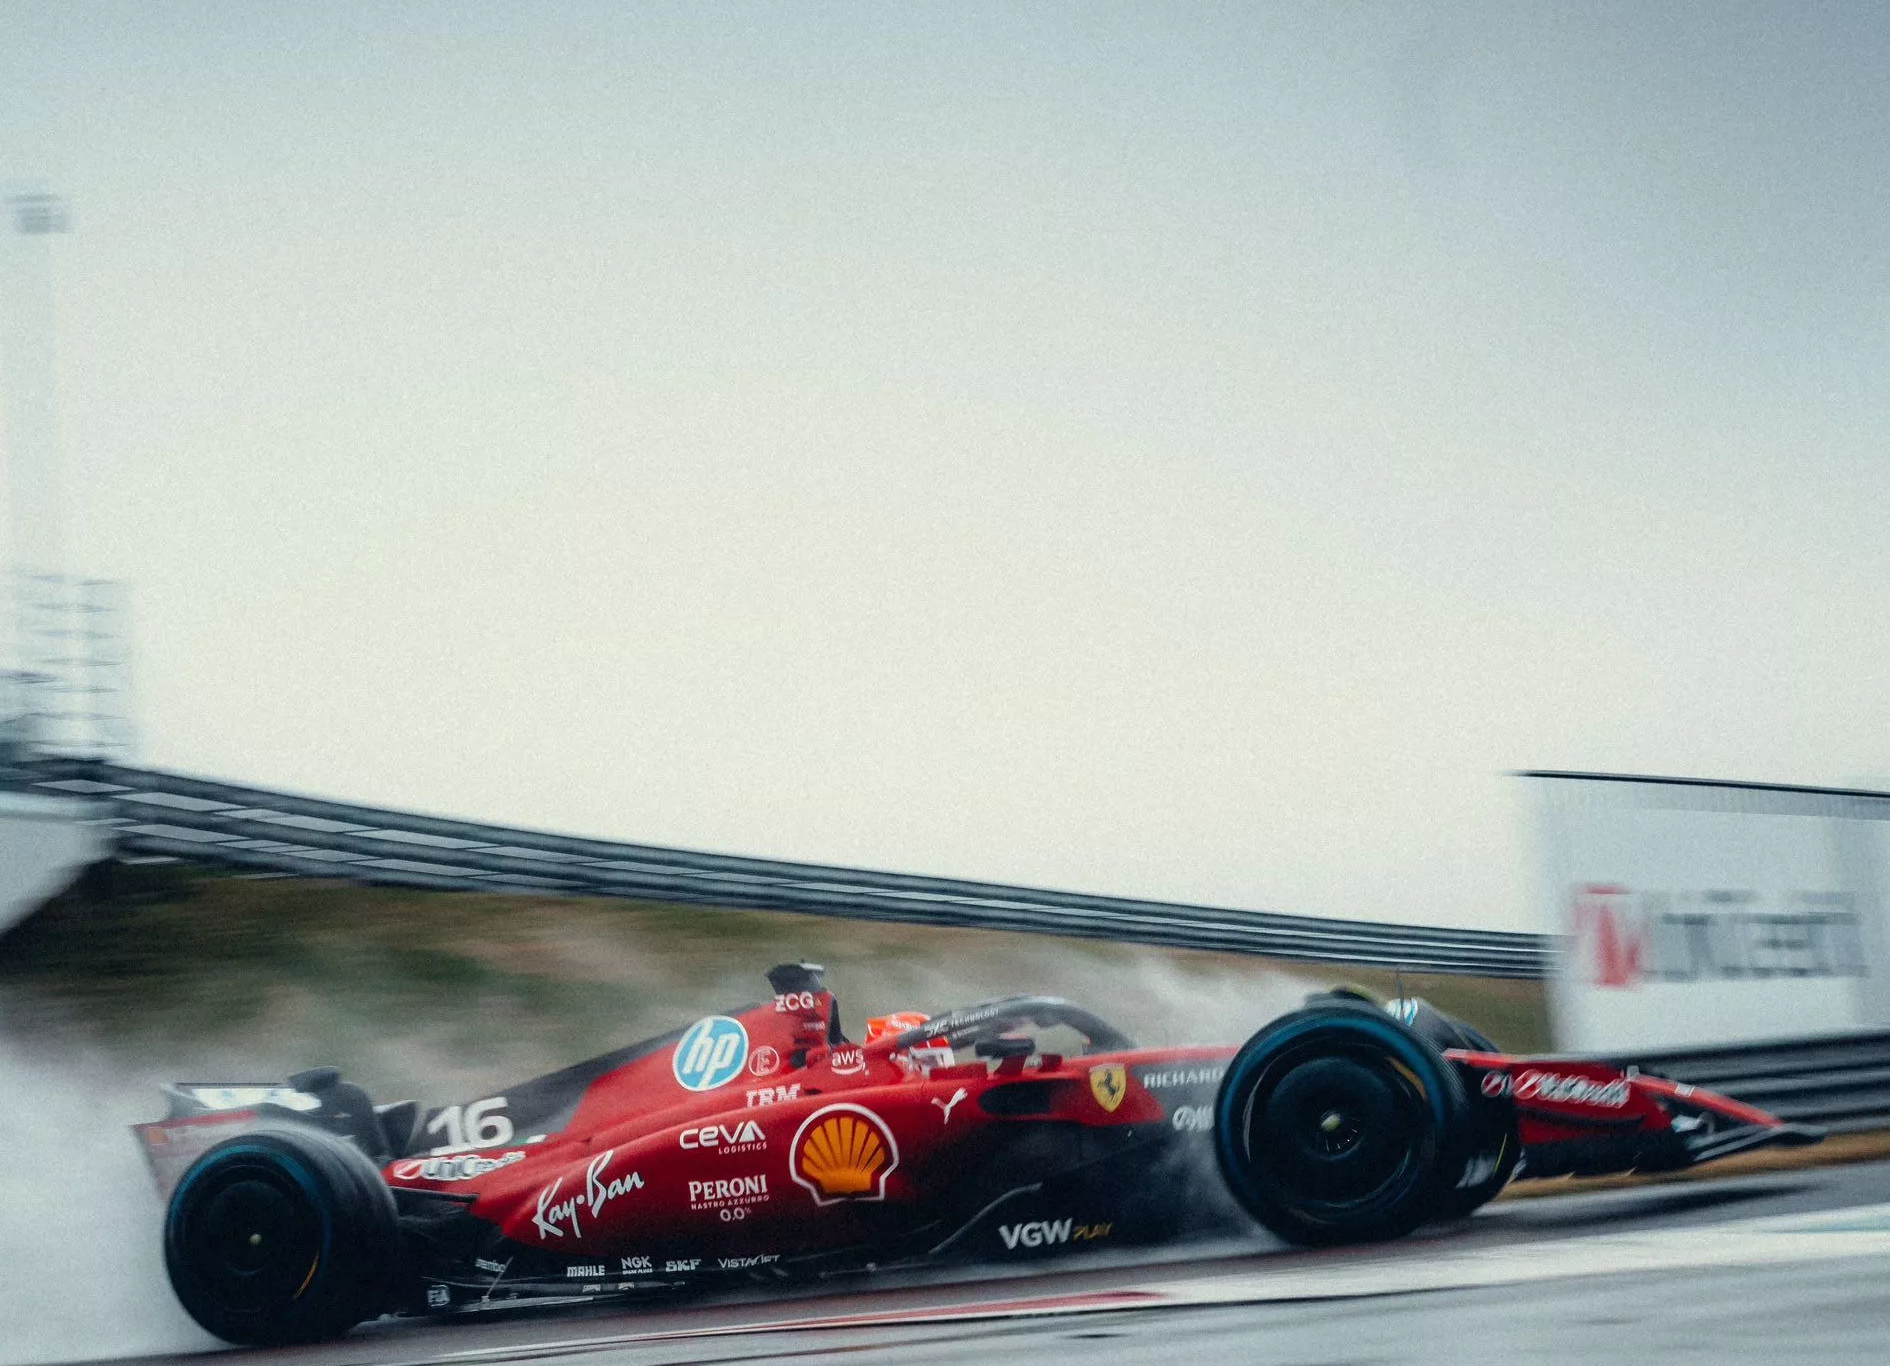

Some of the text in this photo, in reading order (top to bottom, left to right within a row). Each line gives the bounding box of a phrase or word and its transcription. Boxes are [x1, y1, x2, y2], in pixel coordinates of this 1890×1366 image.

[682, 1016, 741, 1090] hp
[832, 1048, 865, 1070] aws
[746, 1083, 801, 1109] IBM
[427, 1096, 514, 1157] 16
[718, 1142, 768, 1155] LOGISTICS
[688, 1174, 768, 1202] PERONI
[690, 1194, 771, 1211] NASTRO AZZURRO
[998, 1217, 1074, 1250] VGW
[566, 1264, 605, 1278] MAHLE
[620, 1255, 653, 1270] NGK
[665, 1258, 702, 1273] SKF
